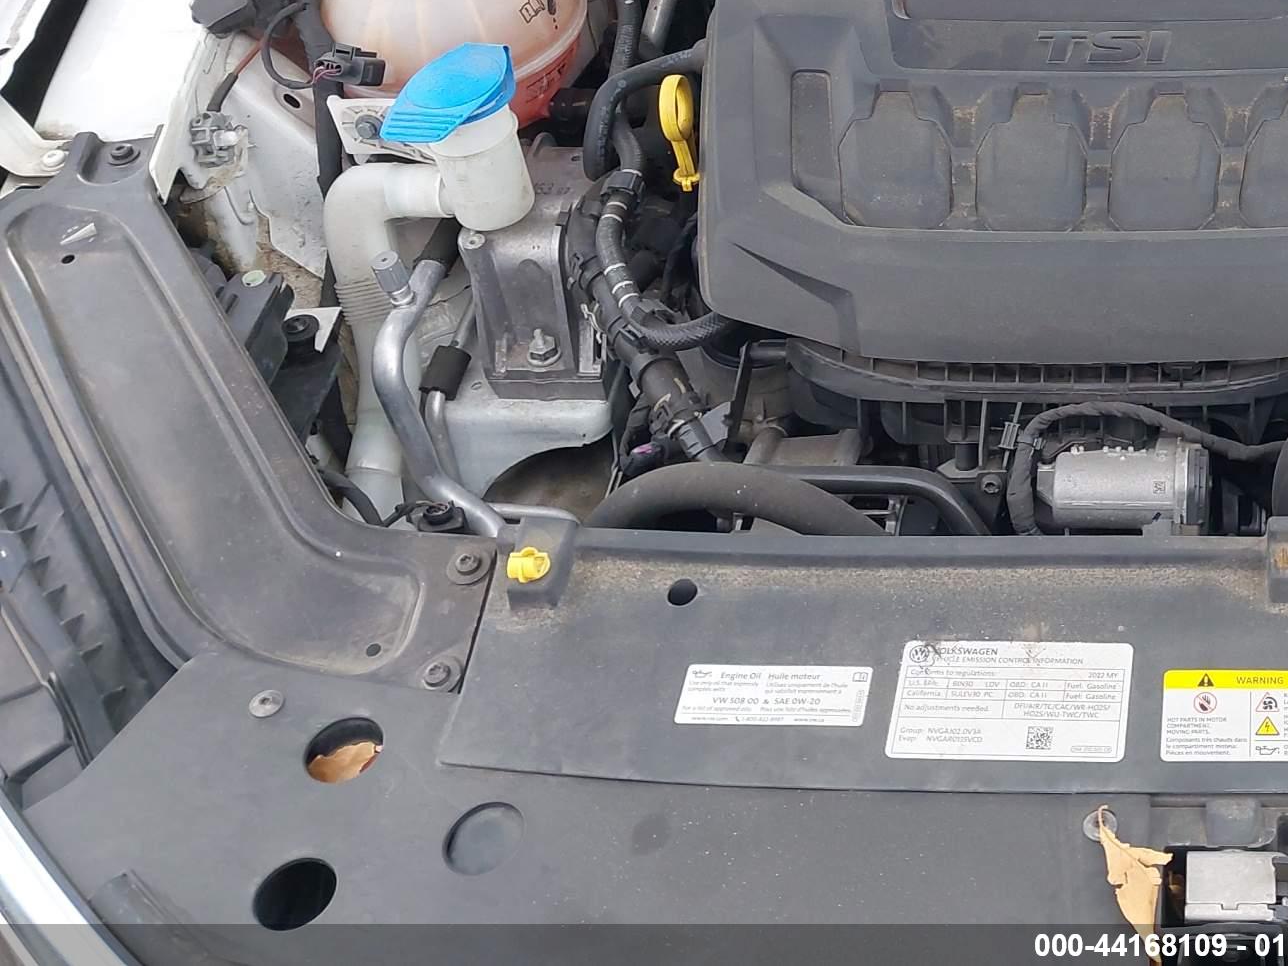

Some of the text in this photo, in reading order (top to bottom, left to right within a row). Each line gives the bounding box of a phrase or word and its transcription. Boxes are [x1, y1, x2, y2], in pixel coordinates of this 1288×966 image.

[1036, 29, 1171, 64] TSI
[720, 672, 748, 680] Engine
[1236, 676, 1284, 684] WARNING
